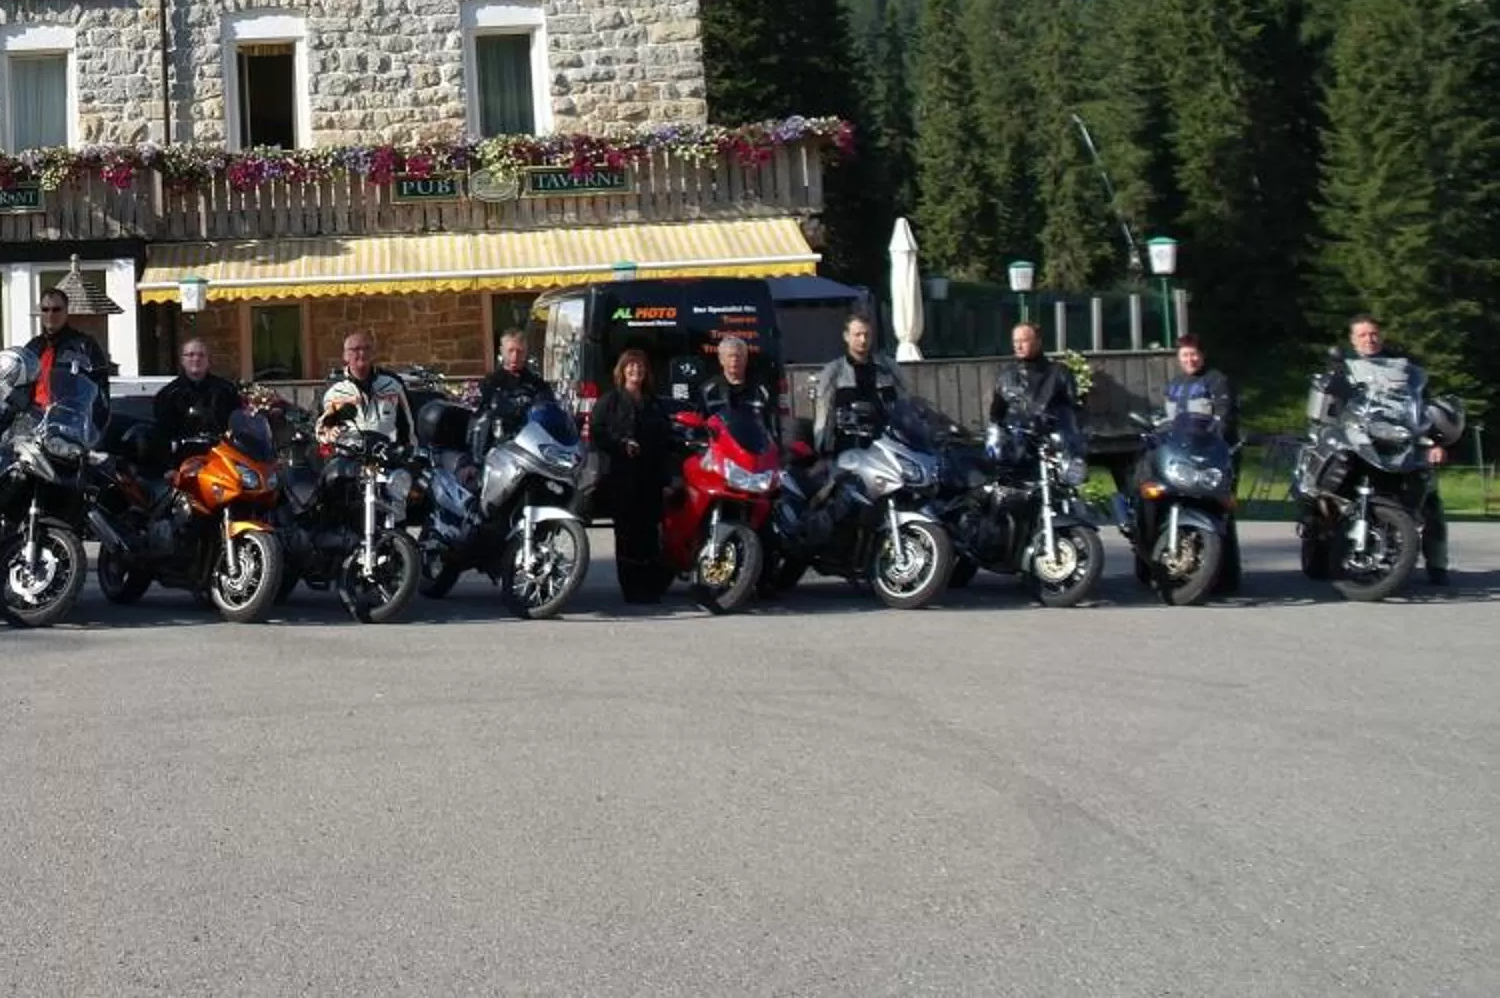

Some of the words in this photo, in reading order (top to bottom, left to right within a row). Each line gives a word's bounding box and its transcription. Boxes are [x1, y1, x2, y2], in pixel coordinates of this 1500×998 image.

[403, 180, 451, 196] PUB
[536, 172, 624, 189] TAVERNE
[612, 307, 633, 319] AL
[635, 307, 677, 319] MOTO
